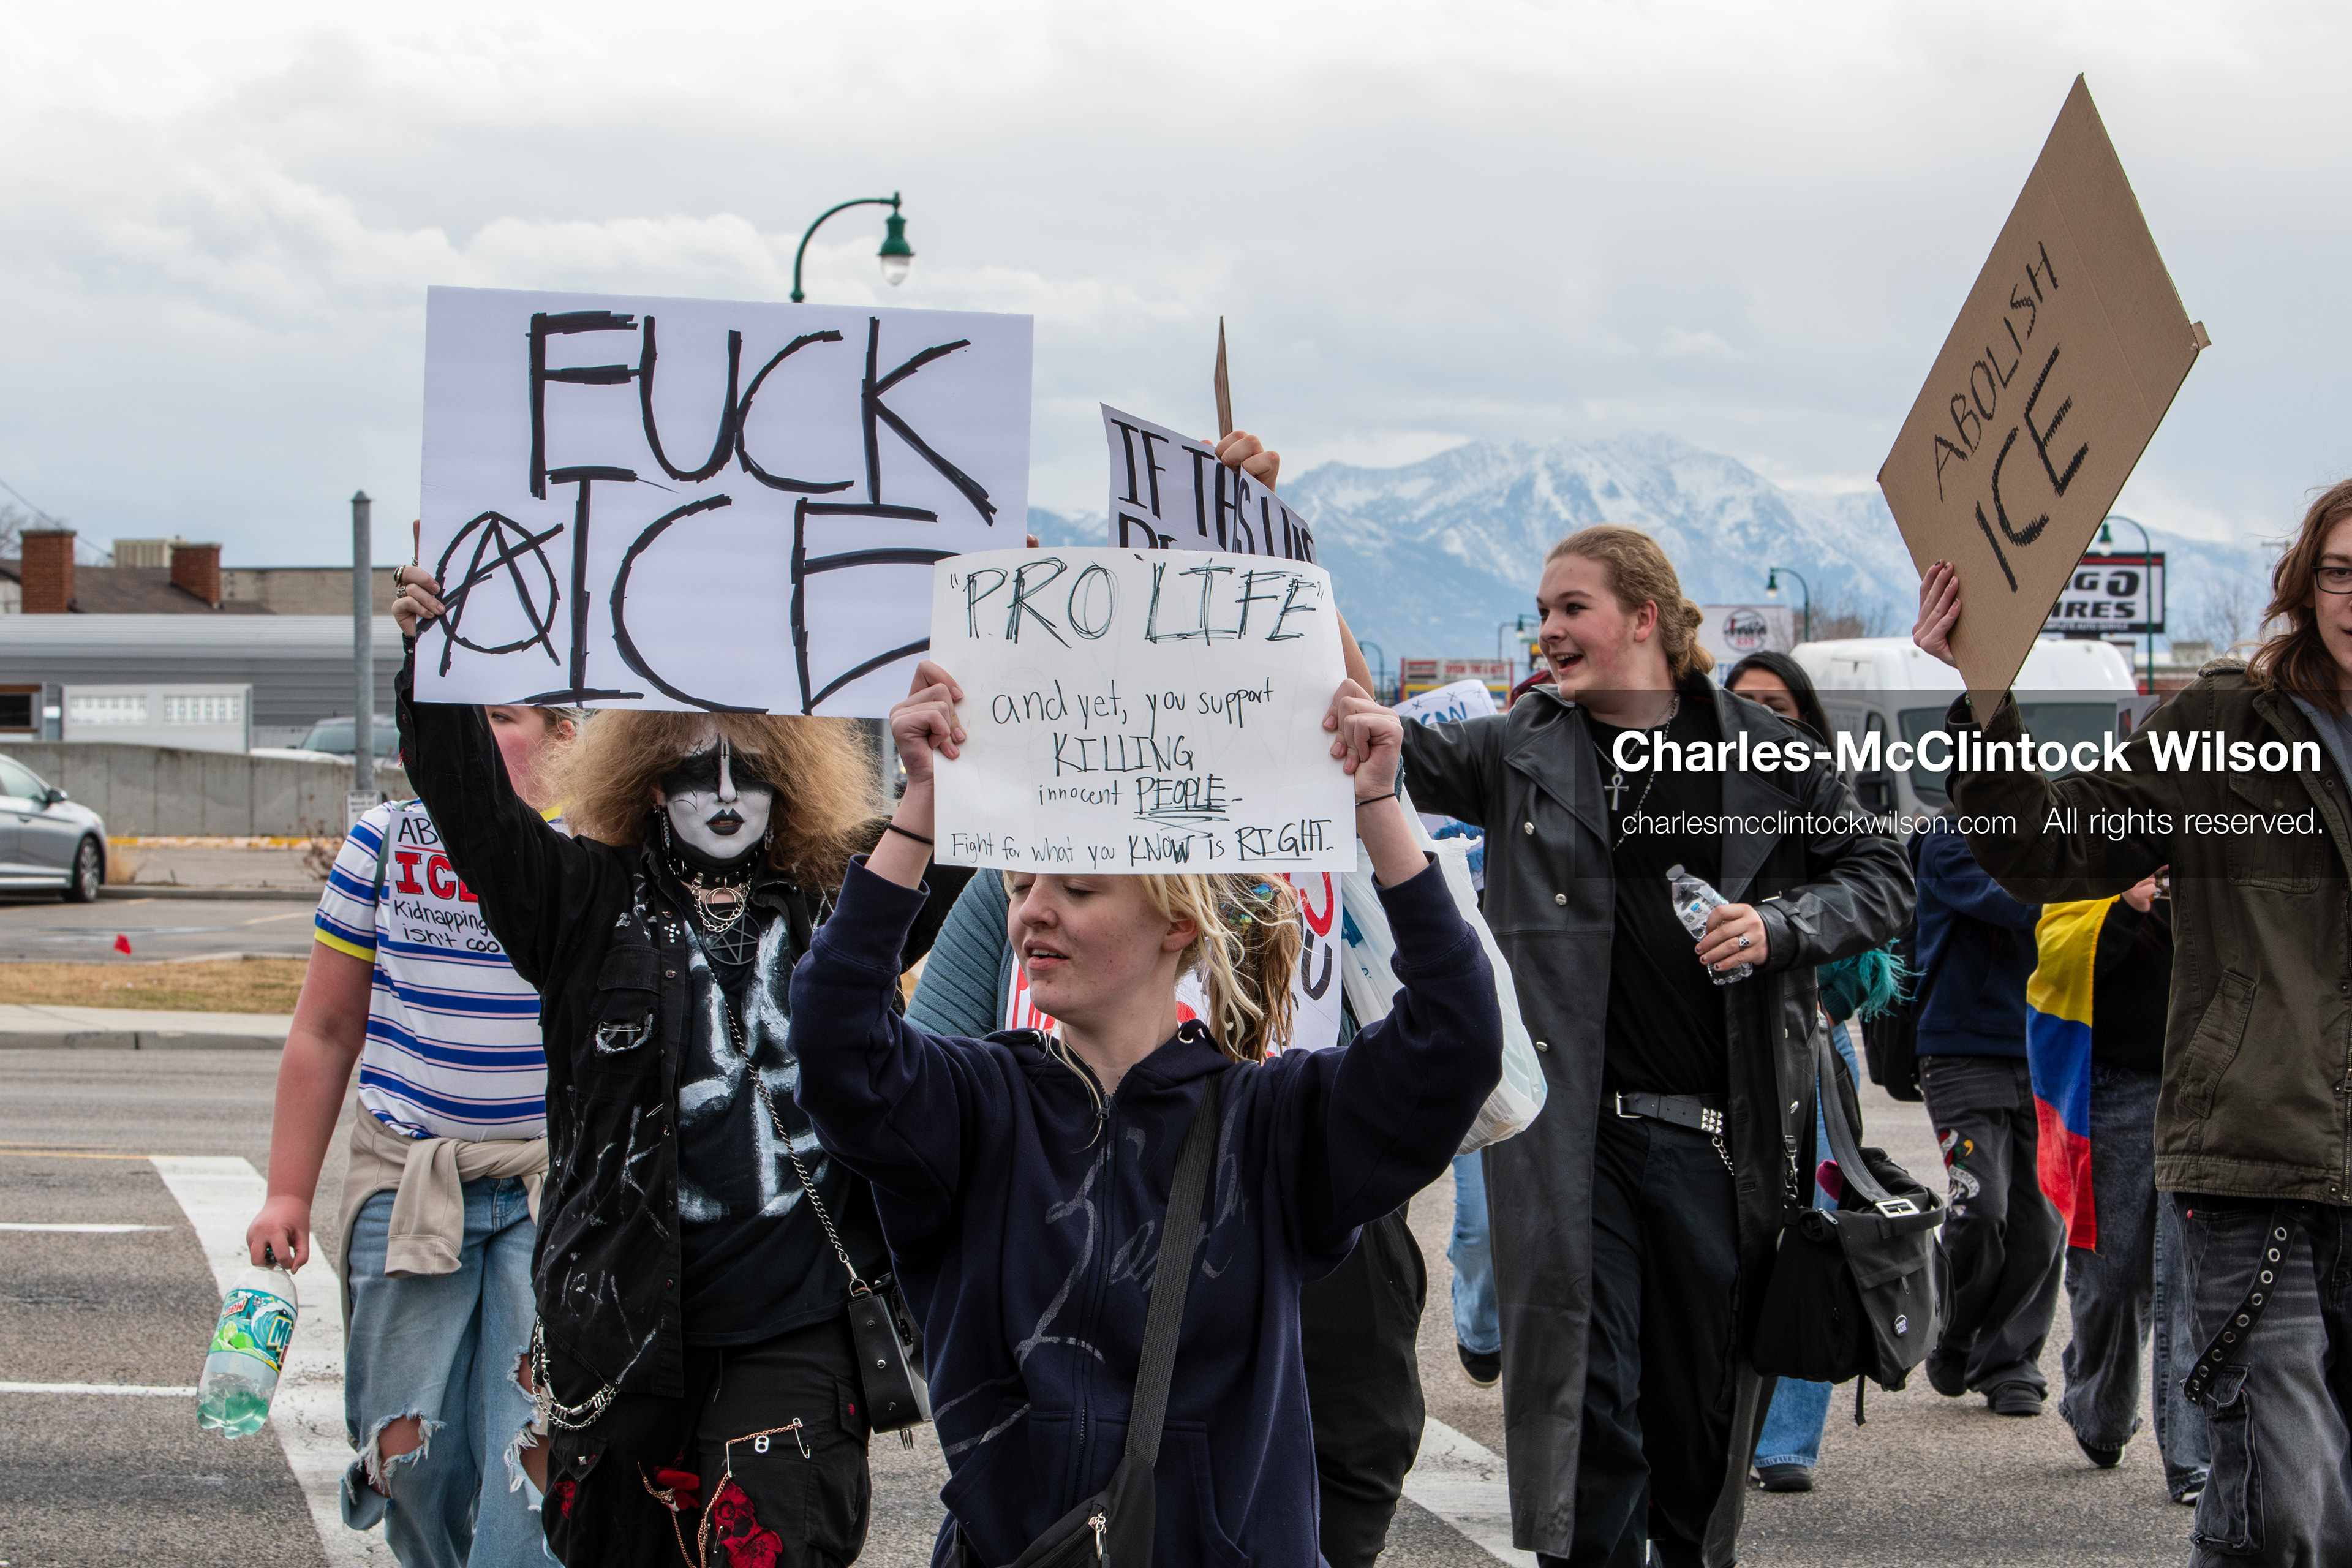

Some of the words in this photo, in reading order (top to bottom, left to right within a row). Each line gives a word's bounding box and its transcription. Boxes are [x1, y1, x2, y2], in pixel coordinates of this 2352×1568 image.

[1935, 241, 2059, 503] ABOLISH
[525, 311, 997, 526] FUCK
[1111, 418, 1169, 520] IF
[1182, 445, 1255, 555] THS
[1975, 342, 2089, 593] ICE
[2052, 601, 2136, 618] IRES
[992, 679, 1068, 725] and
[1145, 691, 1186, 740] you
[1198, 677, 1274, 729] support
[1054, 732, 1194, 777] KILLING
[1039, 779, 1124, 807] innocent
[951, 832, 995, 859] Fight
[1002, 837, 1022, 859] for
[1030, 836, 1074, 862] what
[1088, 845, 1117, 870] you
[1129, 834, 1191, 867] KNOW
[394, 899, 489, 937] Kidnapping
[402, 922, 457, 948] isn't
[466, 938, 500, 954] coo
